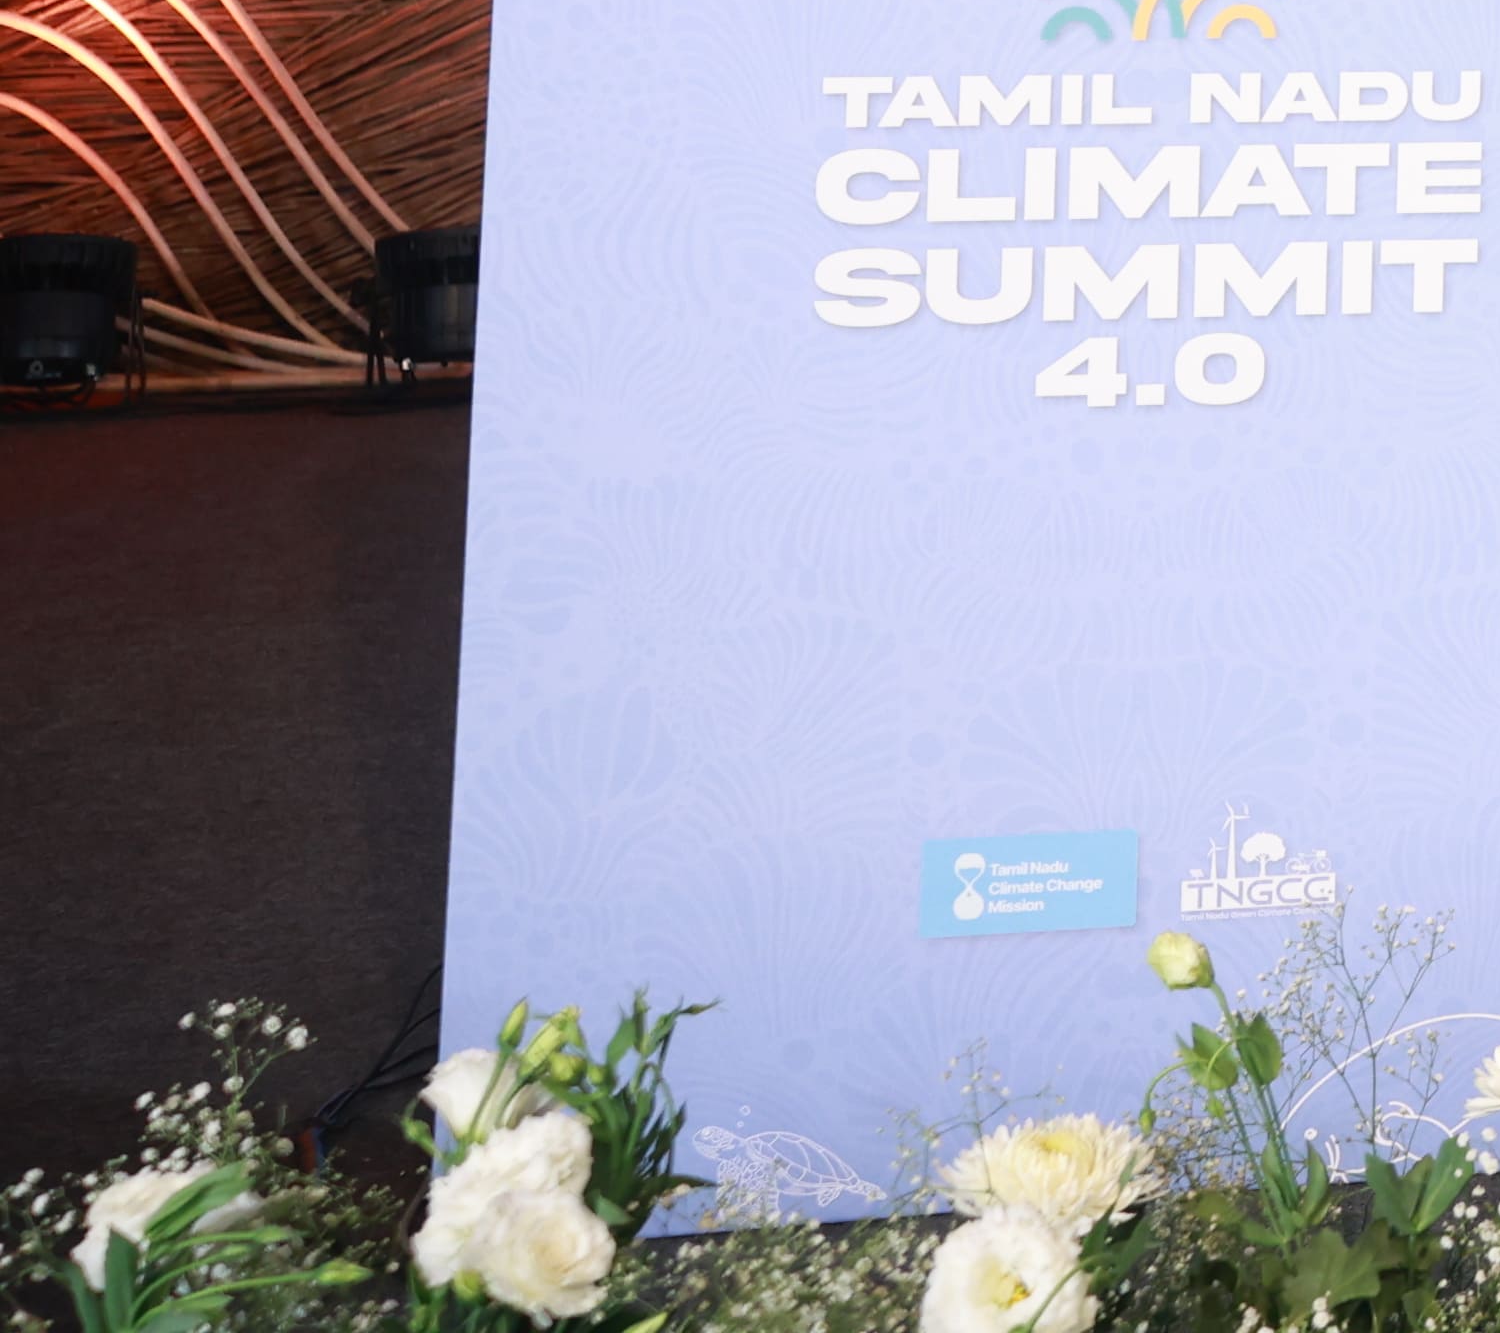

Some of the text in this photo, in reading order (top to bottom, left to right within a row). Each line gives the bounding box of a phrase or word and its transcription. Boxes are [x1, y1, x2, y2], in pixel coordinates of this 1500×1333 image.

[822, 70, 1481, 129] TAMIL NADU
[814, 141, 1483, 226] CLIMATE
[813, 238, 1479, 328] SUMMIT
[1035, 332, 1266, 408] 4.0
[988, 876, 1104, 895] Climate Change
[990, 860, 1069, 877] Tamil Nadu
[988, 898, 1045, 914] Mission
[1187, 876, 1331, 910] TNGCC
